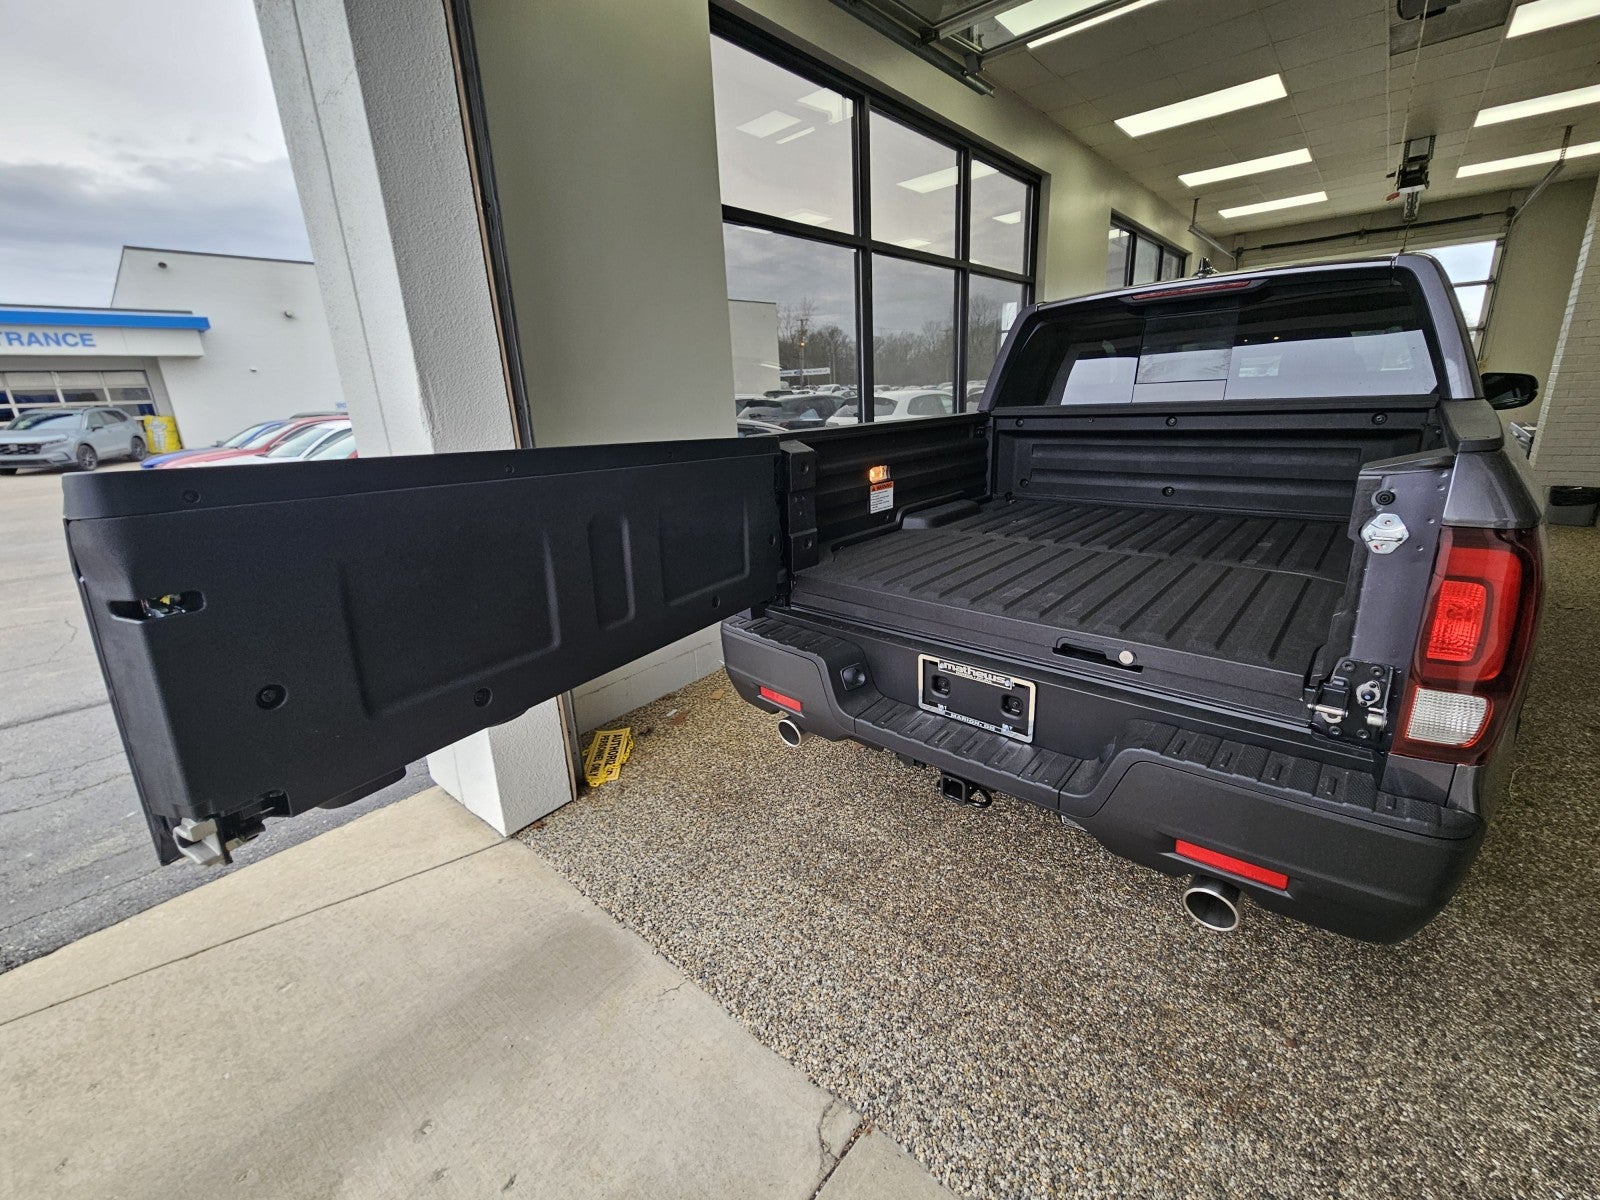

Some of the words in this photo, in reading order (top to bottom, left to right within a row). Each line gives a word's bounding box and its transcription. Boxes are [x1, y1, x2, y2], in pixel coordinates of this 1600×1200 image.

[0, 331, 96, 347] RANCE
[604, 734, 622, 776] AUTHORIZD
[588, 763, 601, 777] ONLY
